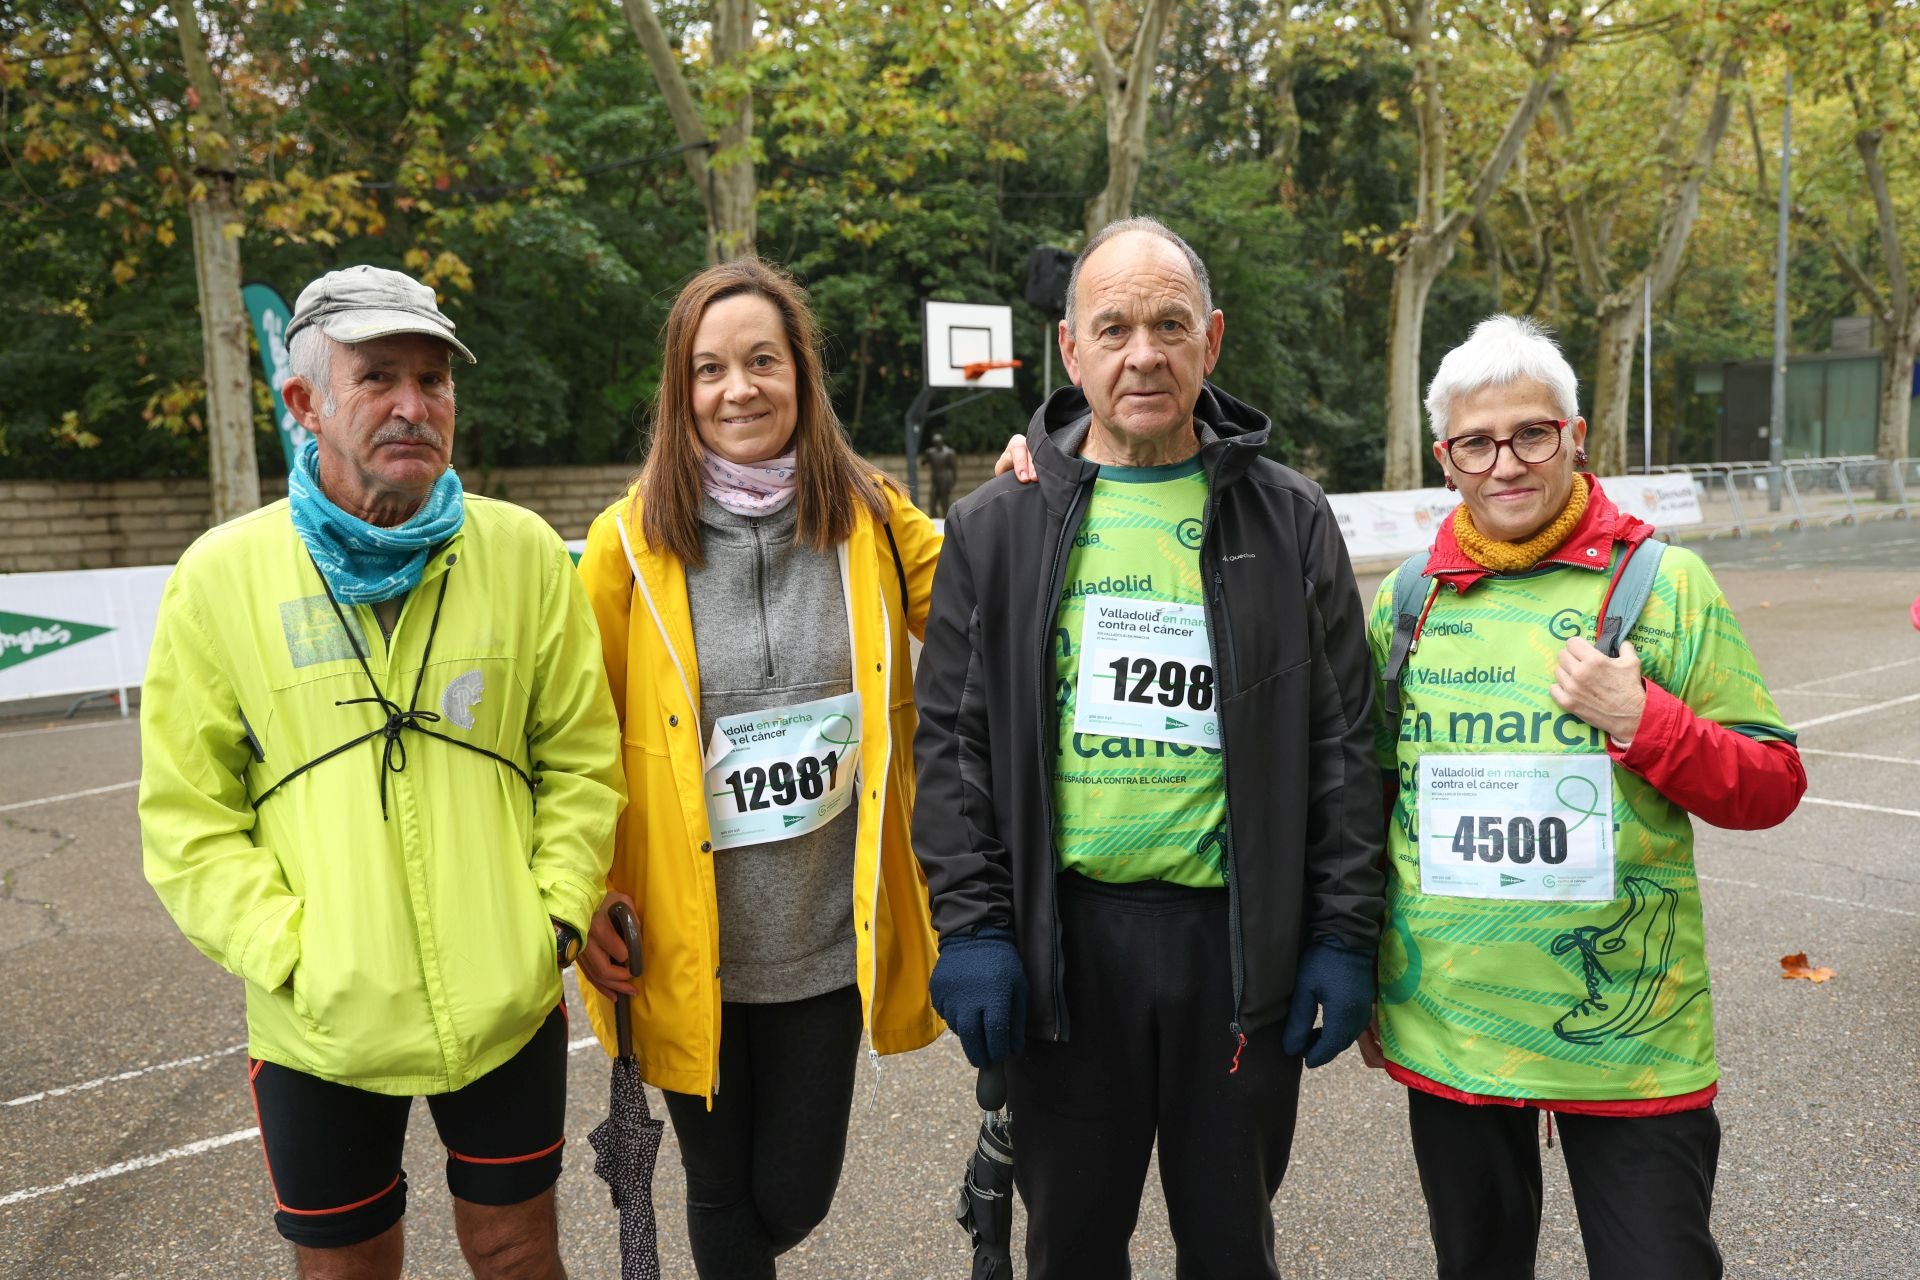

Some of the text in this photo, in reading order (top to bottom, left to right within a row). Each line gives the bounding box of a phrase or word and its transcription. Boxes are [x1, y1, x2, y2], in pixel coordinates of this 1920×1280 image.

[1061, 574, 1153, 600] alladolid
[1100, 608, 1160, 622] Valladolid
[1162, 615, 1177, 624] en
[1098, 620, 1136, 631] contra
[1139, 623, 1151, 633] el
[1153, 625, 1194, 637] cáncer
[1638, 624, 1675, 640] español
[0, 623, 72, 657] nglés
[1109, 656, 1217, 711] 1298
[1417, 666, 1516, 685] Valladolid
[756, 721, 770, 731] en
[772, 713, 813, 727] marcha
[1400, 702, 1432, 742] En
[739, 735, 750, 744] el
[751, 729, 787, 742] cáncer
[1103, 776, 1139, 785] CONTRA
[1139, 776, 1150, 785] EL
[1151, 774, 1187, 784] CÁNCER
[1431, 767, 1550, 778] Valladolid en marcha
[726, 751, 838, 813] 12981
[1431, 779, 1519, 790] contra el cáncer
[1451, 815, 1568, 865] 4500
